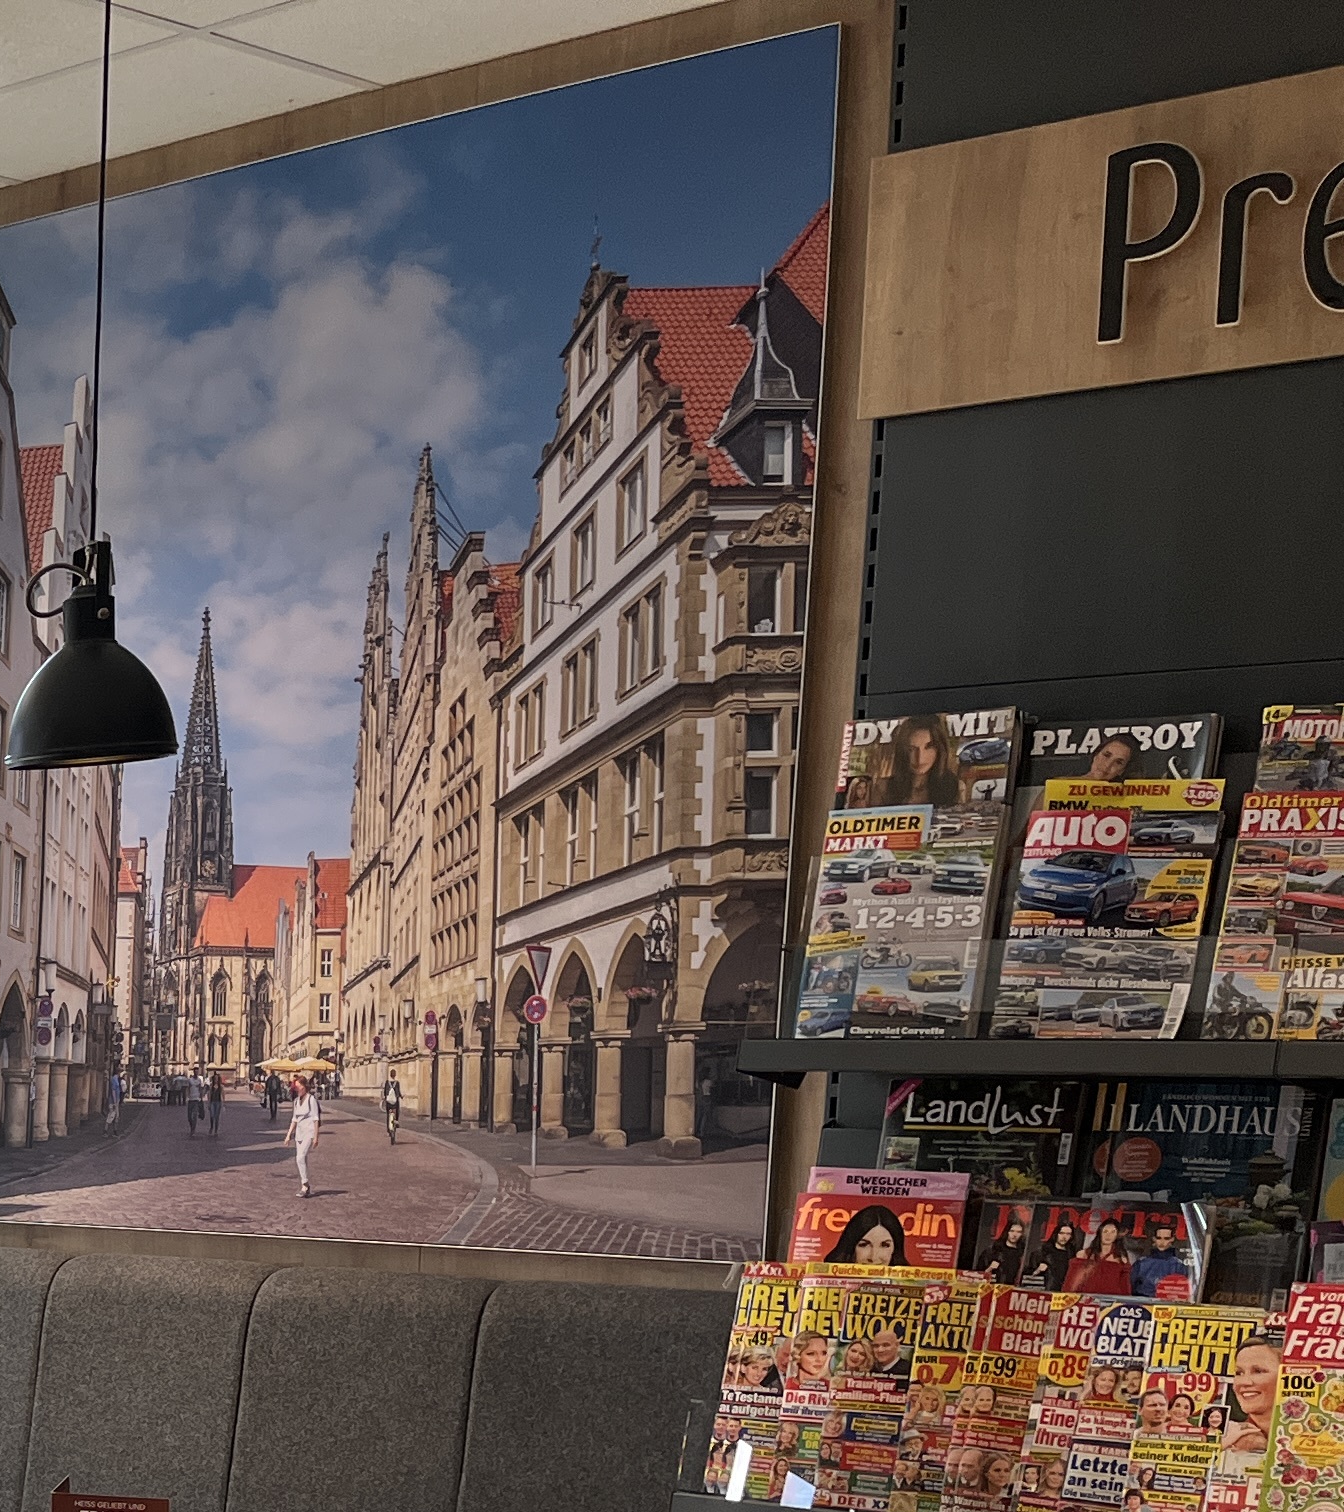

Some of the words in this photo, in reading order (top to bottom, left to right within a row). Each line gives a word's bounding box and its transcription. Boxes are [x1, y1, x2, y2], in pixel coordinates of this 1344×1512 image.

[853, 710, 1013, 747] DYMIT
[1069, 784, 1086, 796] ZU
[1090, 784, 1170, 797] GEWINNEN
[1246, 796, 1343, 809] Oldtimer
[829, 815, 920, 835] OLDTIMER
[825, 836, 888, 852] MARKT
[855, 905, 982, 930] 1-2-4-5-3
[1281, 957, 1332, 970] HEISSE
[1127, 1104, 1302, 1137] LANDHAUS
[846, 1174, 928, 1188] BEWEGLICHER
[861, 1186, 910, 1197] WERDEN
[796, 1197, 956, 1239] fredin
[868, 1268, 885, 1276] und
[1119, 1306, 1143, 1318] DAS
[1155, 1319, 1255, 1346] FREIZEIT
[915, 1356, 938, 1364] NUR
[1152, 1343, 1237, 1376] HEUT
[917, 1357, 965, 1385] 0,7
[1281, 1375, 1315, 1390] 100
[785, 1392, 806, 1404] Die
[1039, 1408, 1075, 1428] Eine
[1132, 1451, 1168, 1462] seiner
[1071, 1454, 1128, 1476] Letzte
[1067, 1475, 1086, 1487] an
[1064, 1489, 1078, 1498] Die
[1210, 1486, 1240, 1504] Ein
[97, 1501, 127, 1510] GELIEBT
[837, 1495, 868, 1508] DER
